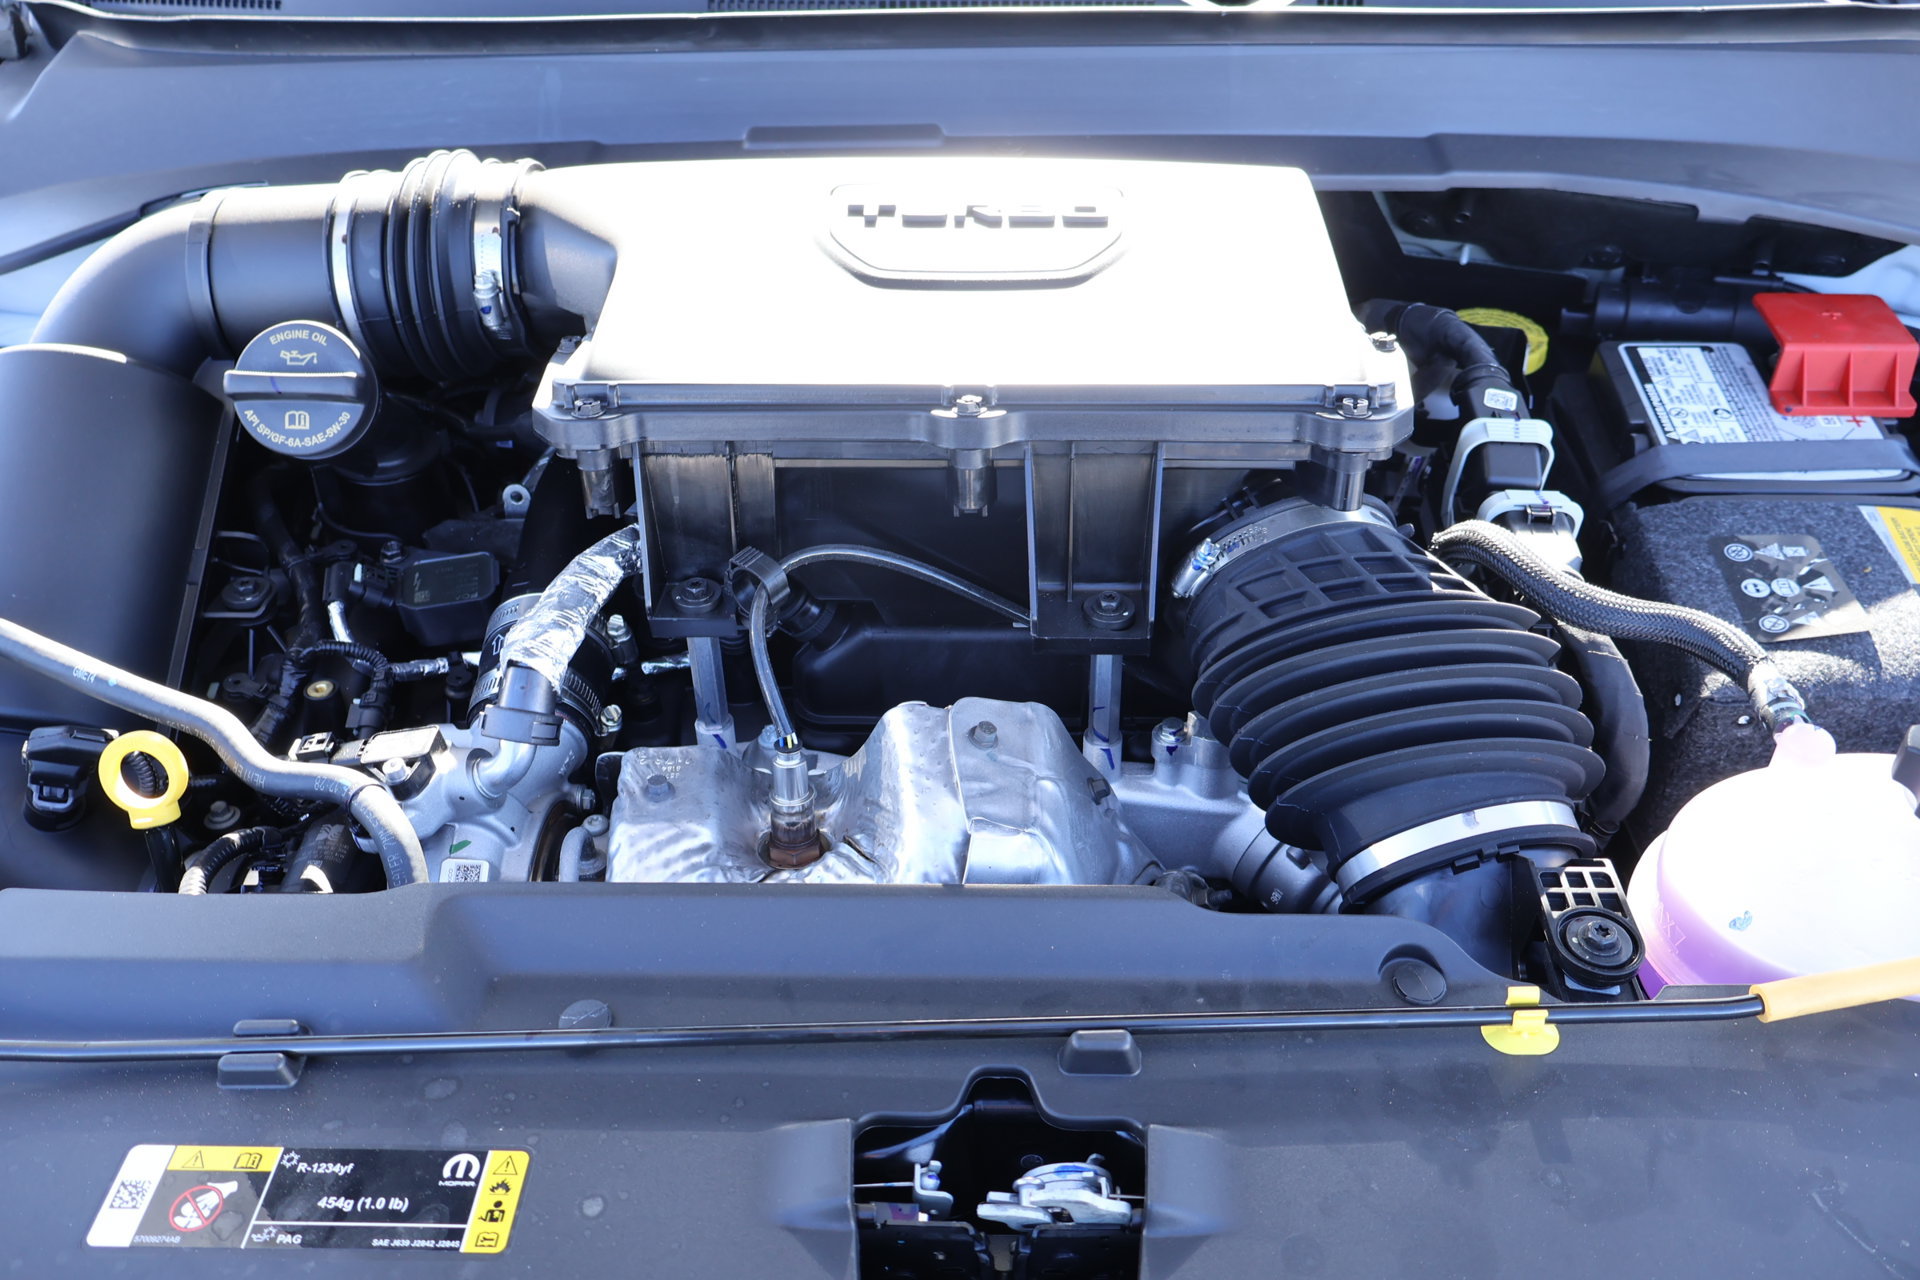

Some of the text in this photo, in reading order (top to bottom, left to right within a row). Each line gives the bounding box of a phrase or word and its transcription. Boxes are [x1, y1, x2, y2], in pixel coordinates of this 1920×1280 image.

[269, 330, 328, 346] ENGINE OIL
[244, 410, 259, 427] API
[296, 1162, 355, 1176] R-1234yf
[317, 1196, 409, 1212] 454g (1.0 lb)
[276, 1234, 303, 1245] PAG
[371, 1239, 390, 1247] SAE
